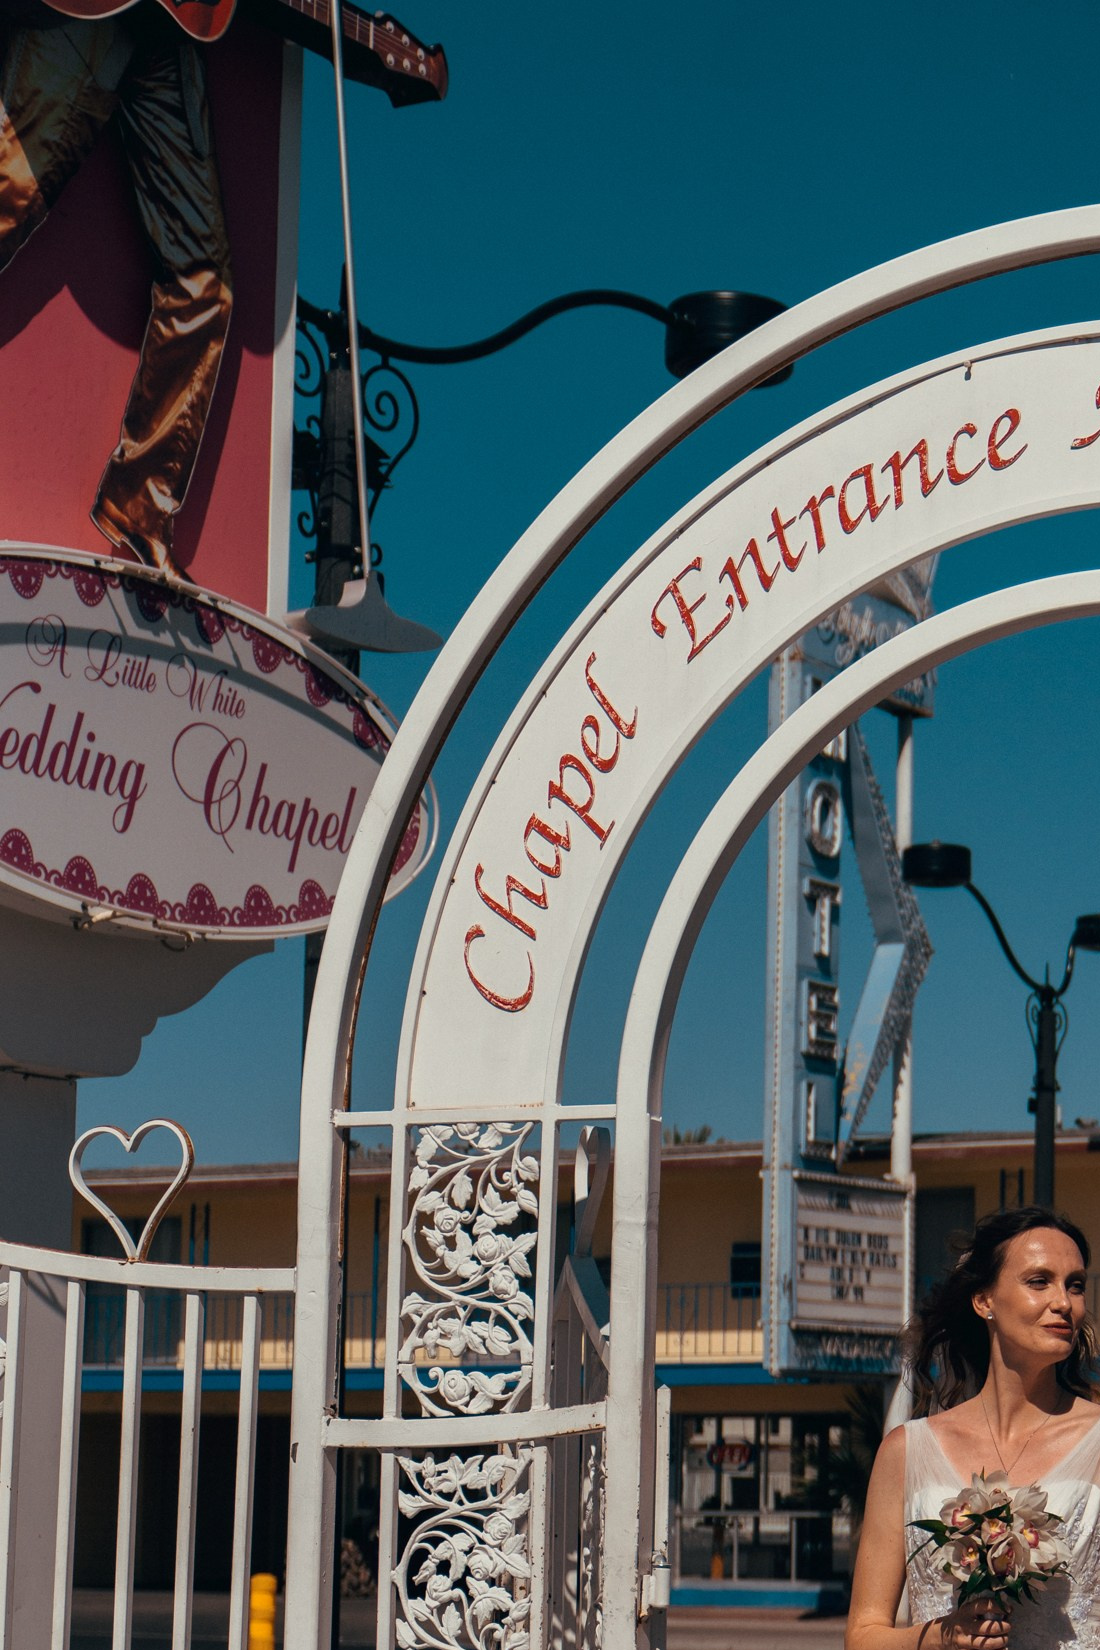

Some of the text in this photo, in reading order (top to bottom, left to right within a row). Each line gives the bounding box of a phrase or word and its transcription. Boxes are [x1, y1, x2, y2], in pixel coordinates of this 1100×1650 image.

[25, 614, 247, 720] A Little White
[462, 650, 639, 1013] Chapel
[650, 406, 1028, 664] Entrance
[0, 681, 358, 874] edding Chapel
